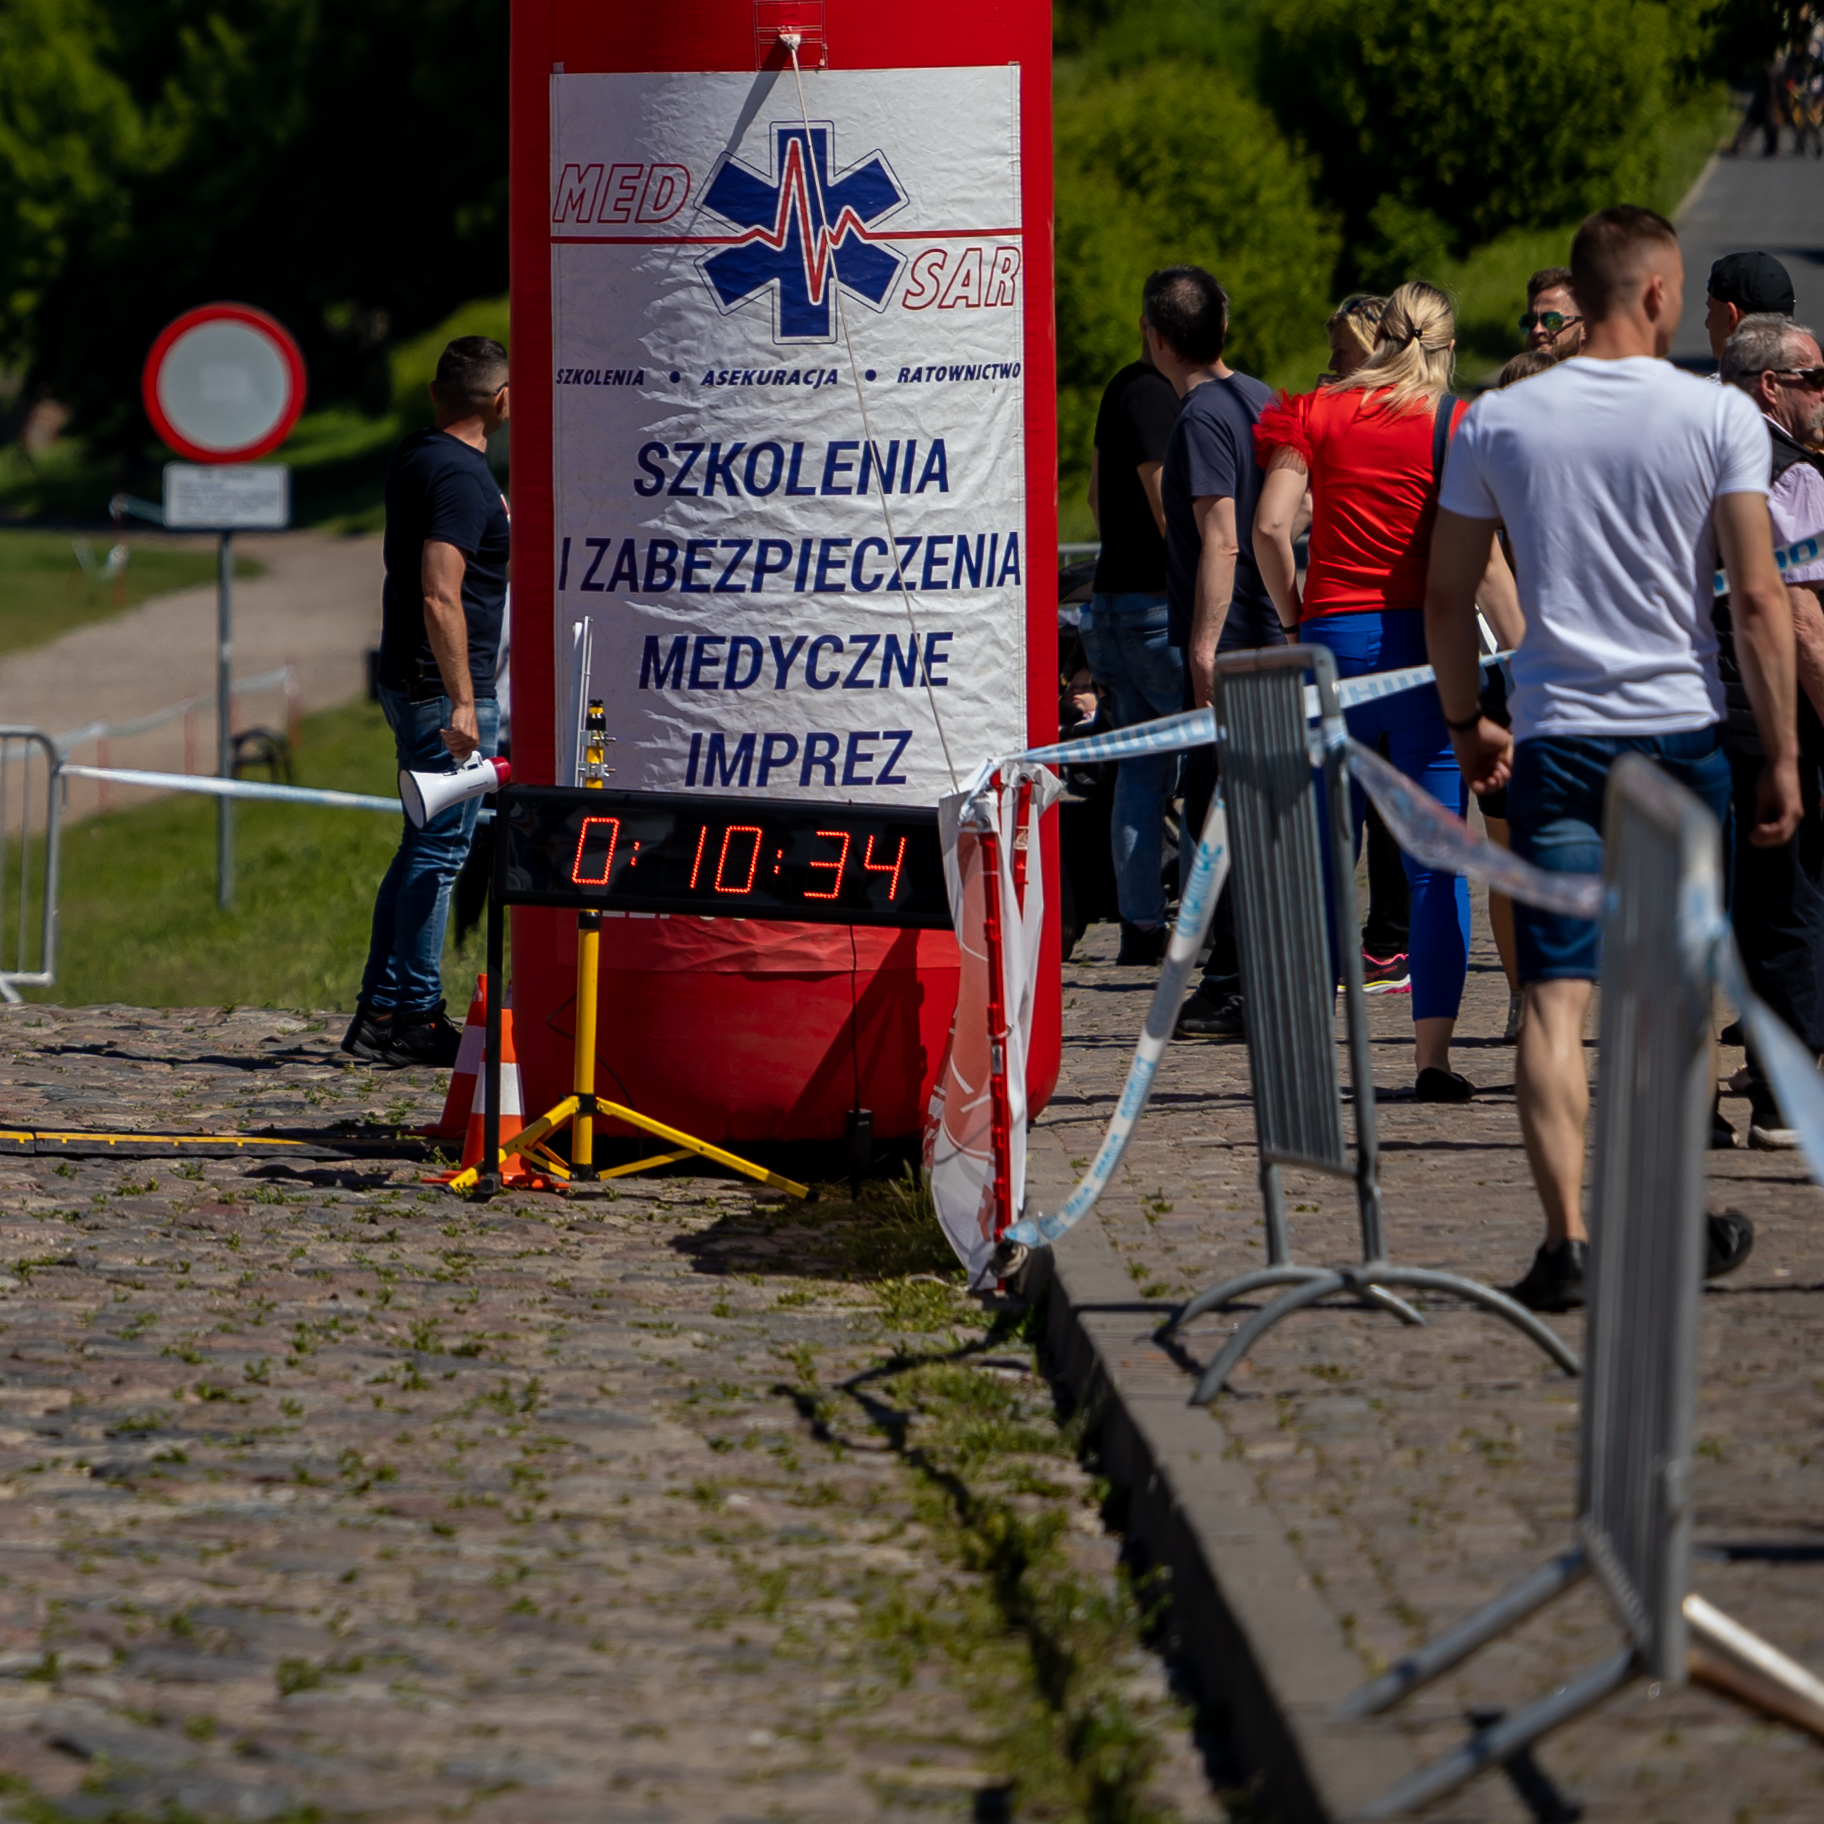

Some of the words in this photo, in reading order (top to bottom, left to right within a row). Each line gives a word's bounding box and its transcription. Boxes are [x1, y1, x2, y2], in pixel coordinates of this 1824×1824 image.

[553, 163, 692, 224] MED
[900, 246, 1021, 311] SAR
[555, 368, 645, 386] SZKOLENIA
[700, 368, 839, 389] ASEKURACJA
[897, 361, 1022, 384] RATOWNICTWO
[633, 438, 950, 498] SZKOLENIA
[557, 536, 571, 592] I
[579, 531, 1021, 594] ZABEZPIECZENIA
[638, 631, 954, 691] MEDYCZNE
[684, 730, 913, 788] IMPREZ
